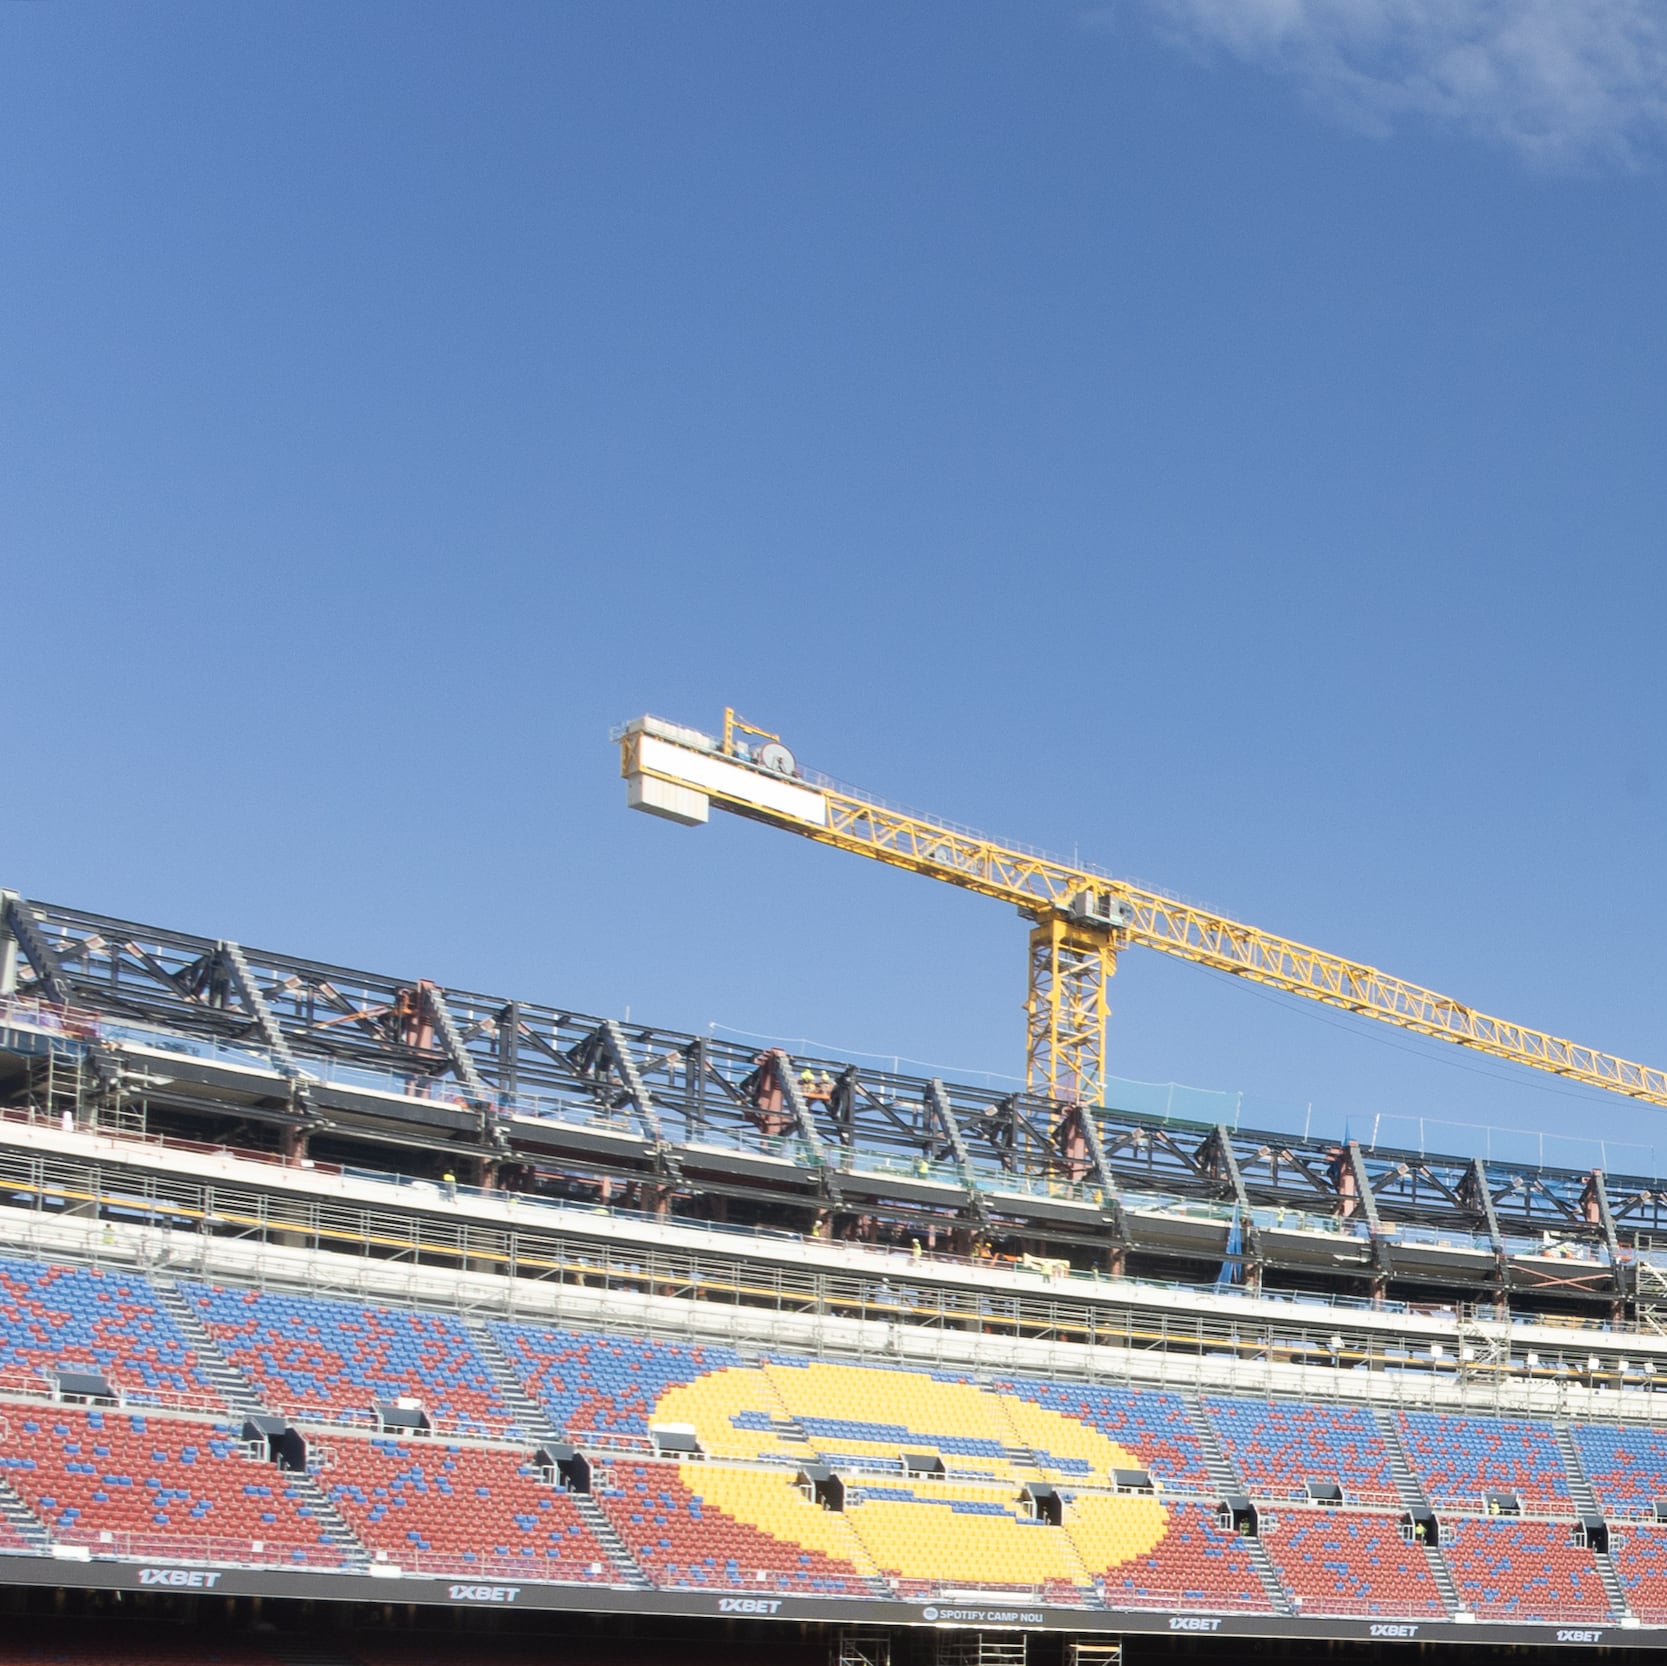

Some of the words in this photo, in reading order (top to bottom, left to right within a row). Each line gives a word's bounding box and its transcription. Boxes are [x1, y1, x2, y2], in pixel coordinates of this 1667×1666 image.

[137, 1568, 222, 1588] 1XBET
[447, 1585, 521, 1603] 1XBET
[718, 1598, 782, 1615] 1XBET
[940, 1609, 986, 1620] SPOTIFY
[987, 1611, 1019, 1622] CAMP
[1020, 1612, 1043, 1623] NOU
[1169, 1617, 1222, 1631] 1XBET
[1369, 1624, 1419, 1637] 1XBET
[1556, 1629, 1602, 1642] 1XBET
